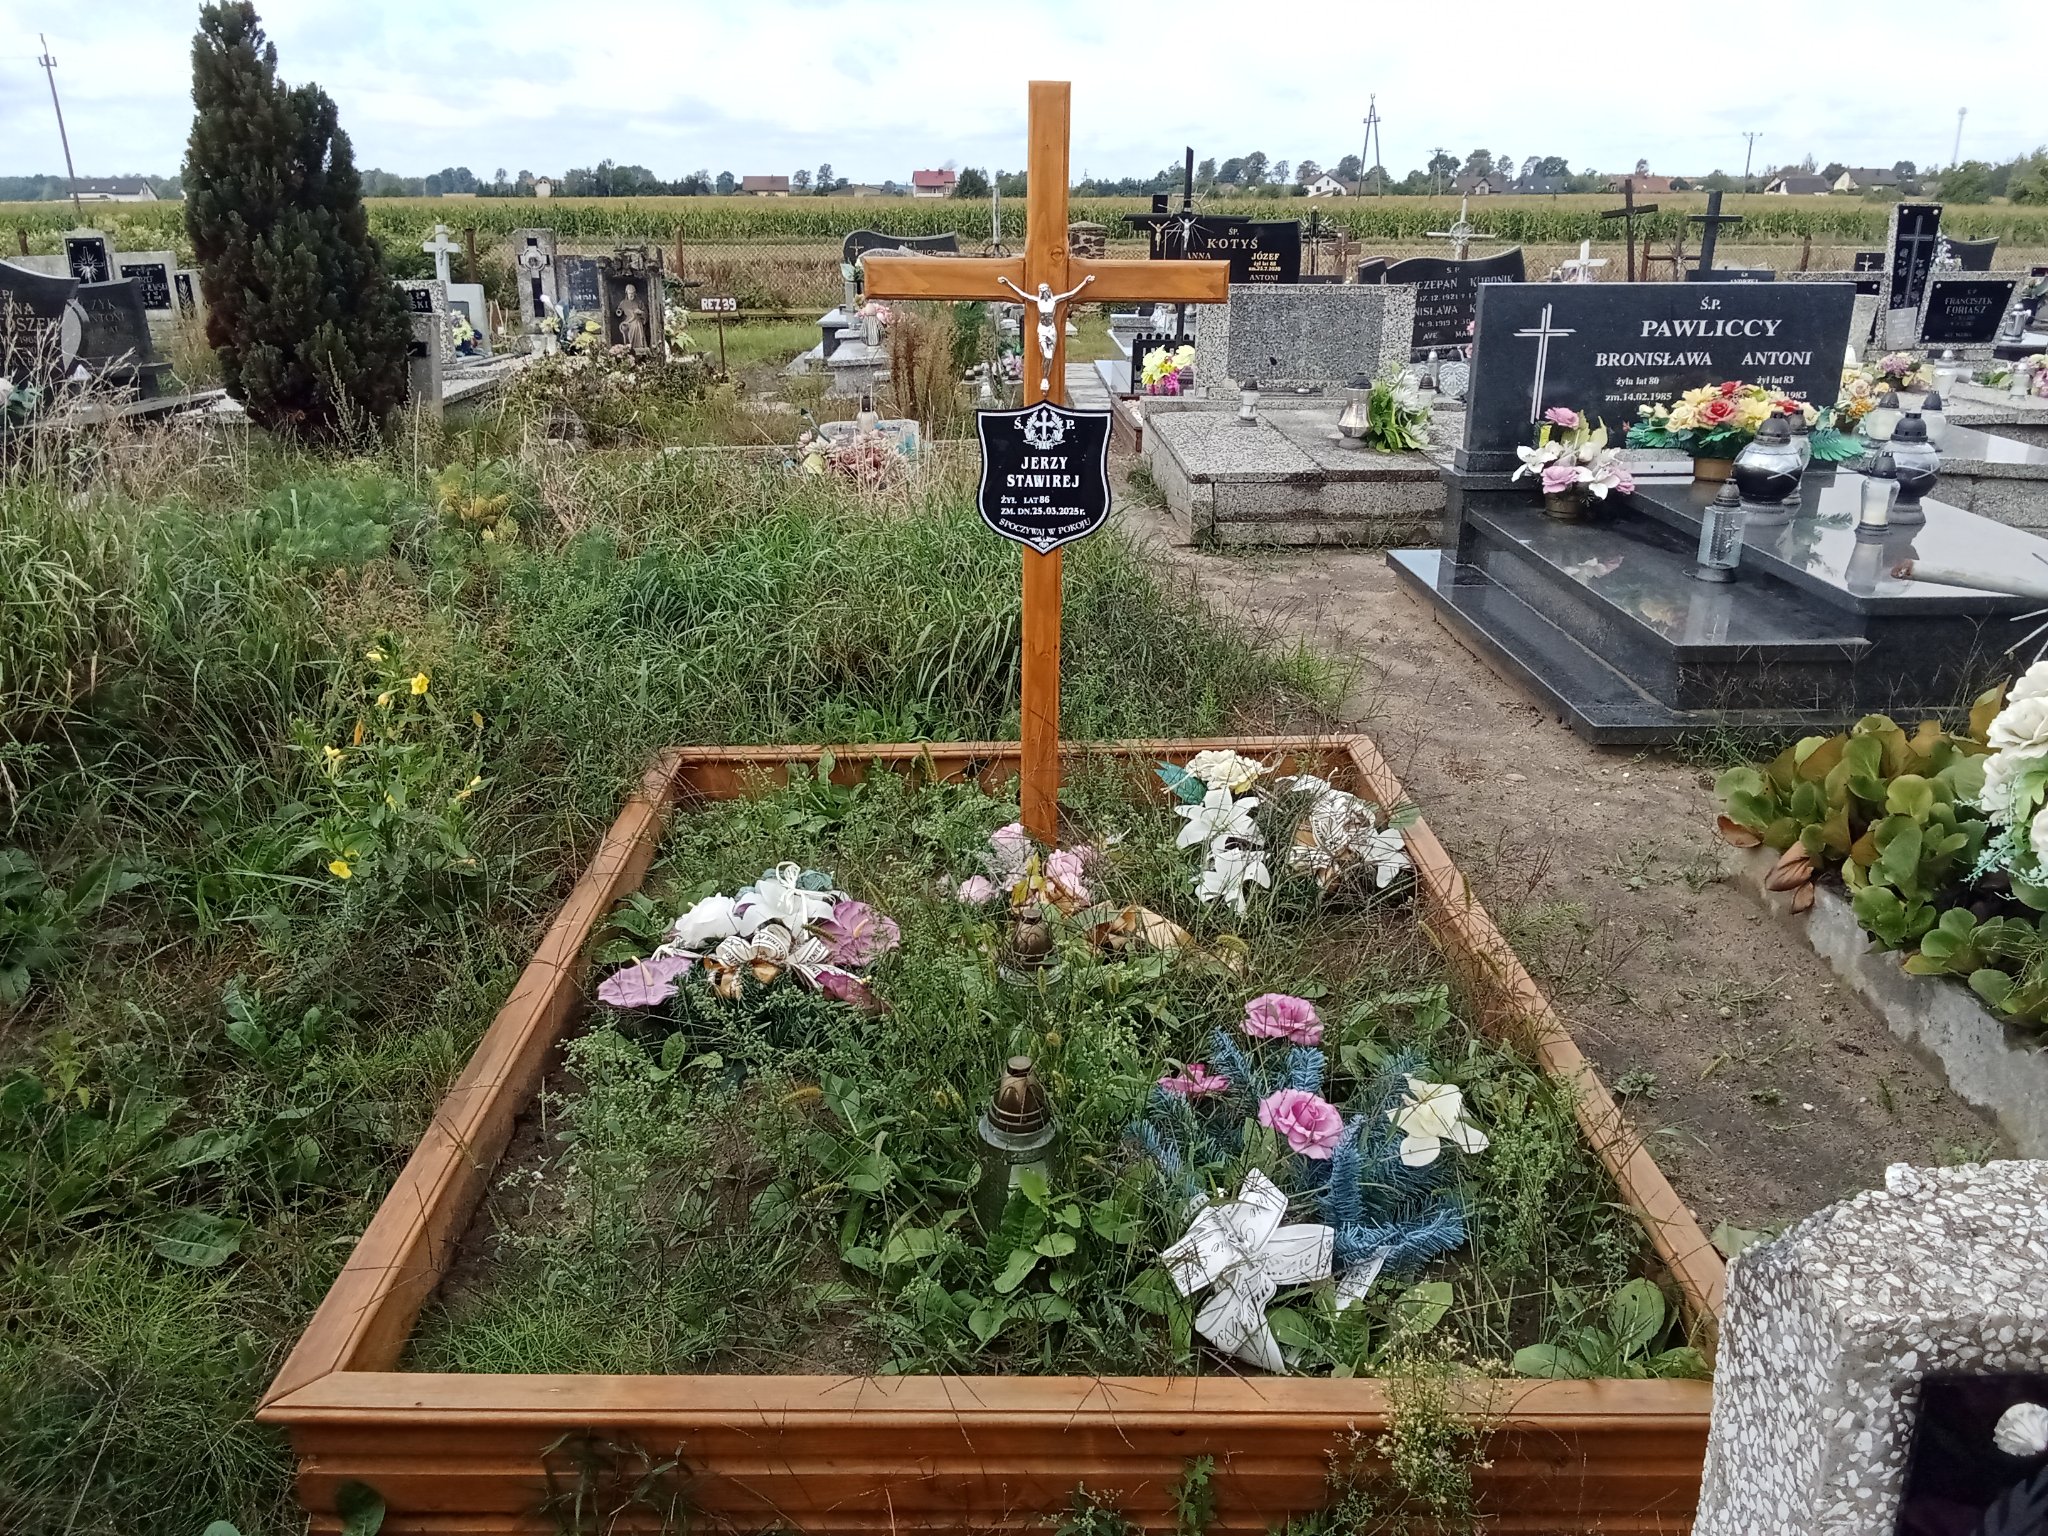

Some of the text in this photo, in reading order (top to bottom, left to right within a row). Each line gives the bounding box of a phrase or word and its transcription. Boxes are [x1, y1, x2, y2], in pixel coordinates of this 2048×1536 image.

[1206, 237, 1258, 250] KOTYŚ
[1251, 250, 1280, 261] JÓZEF
[701, 298, 737, 311] REZ 39
[1640, 319, 1783, 338] PAWLICCY
[1595, 351, 1814, 367] BRONISŁAWA ANTONI
[1648, 376, 1660, 385] 80
[1783, 375, 1794, 384] 83
[1020, 456, 1068, 470] JERZY
[1006, 474, 1080, 488] STAWIREJ
[1039, 495, 1050, 504] 86
[1000, 507, 1016, 516] ZM.
[998, 517, 1092, 537] SPOCZYWAJ W POKOJU
